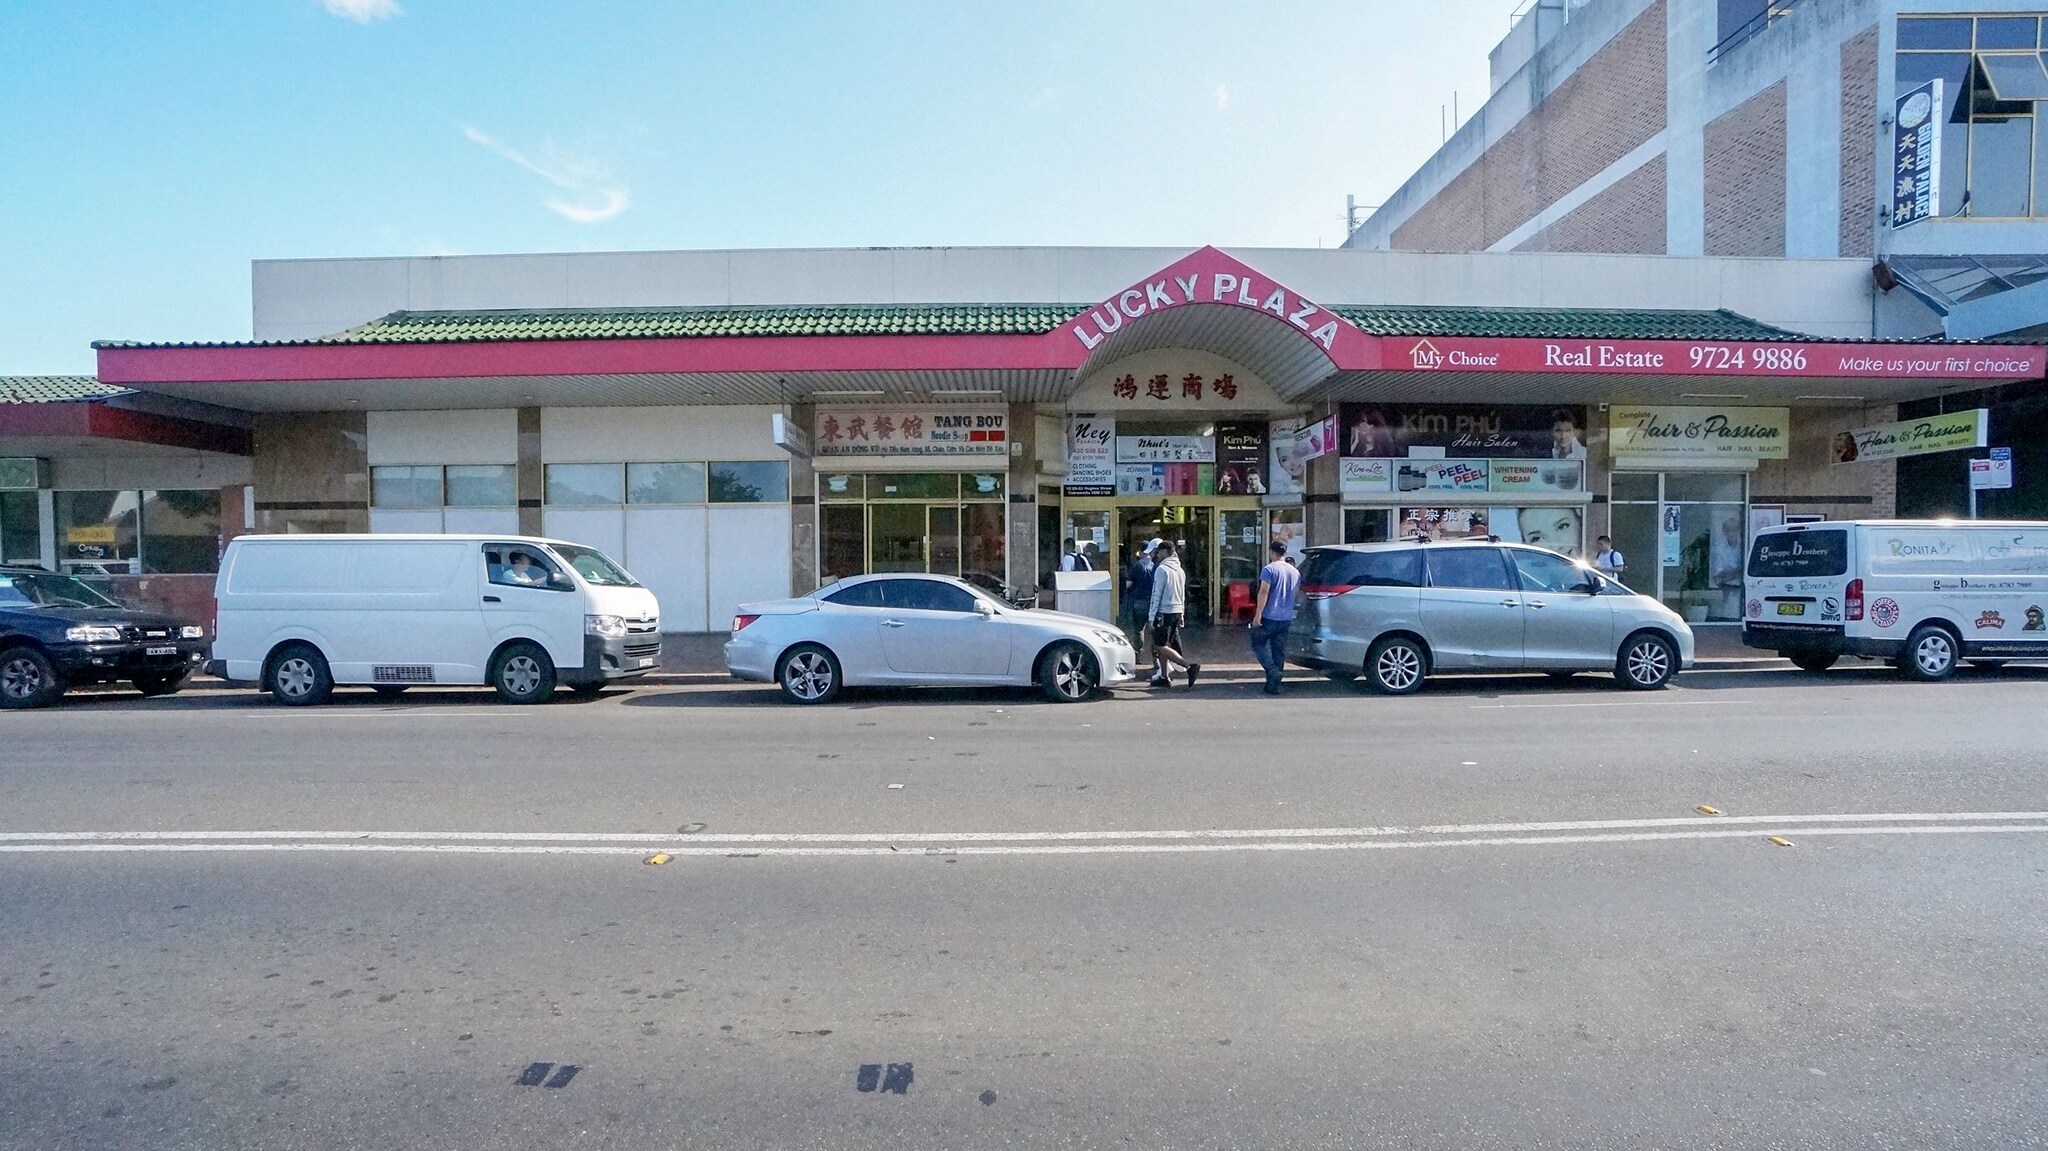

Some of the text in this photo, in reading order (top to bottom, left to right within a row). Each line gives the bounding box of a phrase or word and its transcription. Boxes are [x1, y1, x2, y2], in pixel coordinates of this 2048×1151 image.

[1894, 133, 1916, 222] 天天漁村
[1914, 122, 1931, 218] GOLDEN PALACE
[1073, 273, 1339, 350] LUCKY PLAZA
[1417, 350, 1497, 369] My Choice
[1545, 344, 1807, 370] Real Estate 9724 9886
[1838, 356, 2030, 374] Make us your first choice
[1113, 373, 1238, 400] 鴻運商場
[819, 415, 924, 442] 東武餐館
[934, 415, 1003, 427] TANG BOU
[1628, 414, 1780, 444] Hair & Passion
[1075, 423, 1112, 445] Ney
[1224, 434, 1261, 444] Kim Phú
[1451, 433, 1518, 447] Hair Salon
[1860, 431, 1897, 452] Hair
[1913, 423, 1972, 442] Passion
[1425, 464, 1446, 473] PEEL
[1438, 463, 1472, 479] PEEL
[1453, 470, 1487, 486] PEEL
[1887, 538, 1938, 557] RONITA
